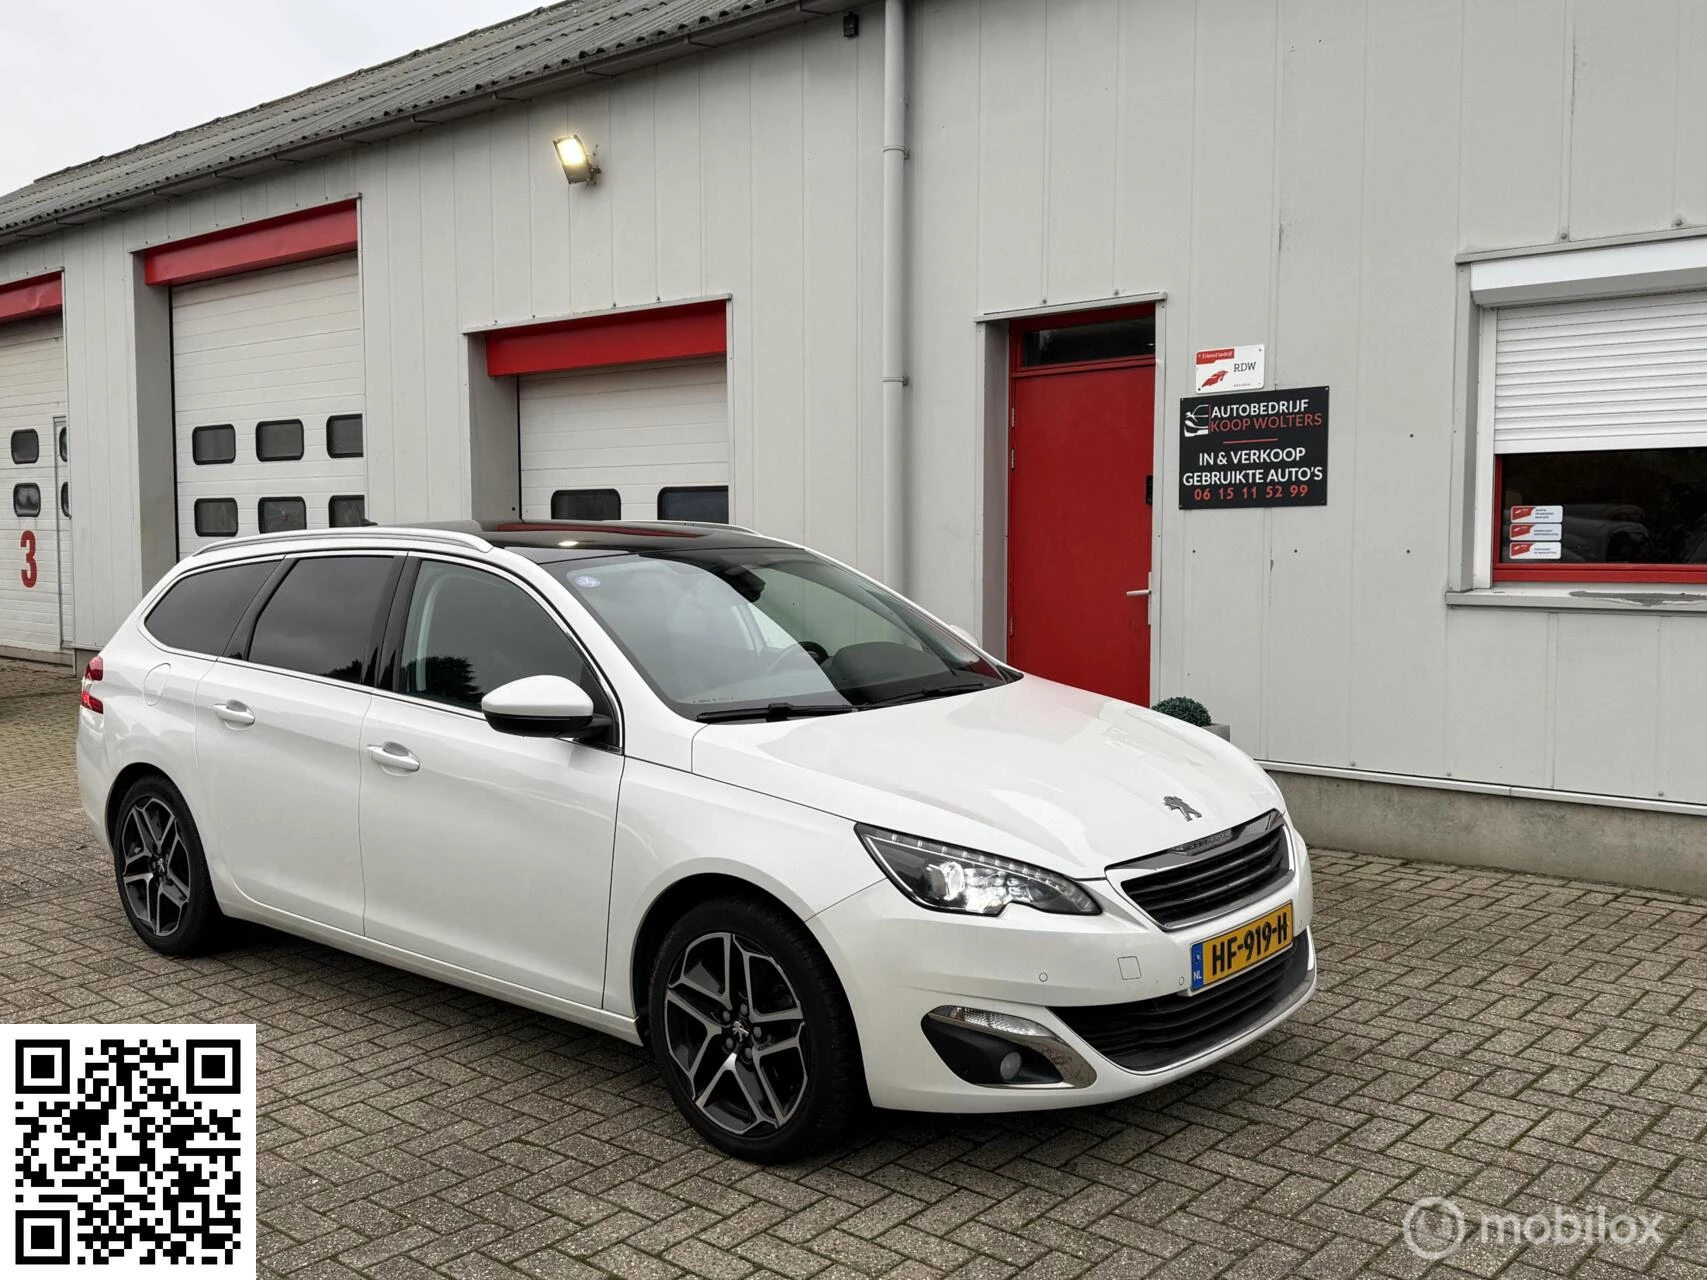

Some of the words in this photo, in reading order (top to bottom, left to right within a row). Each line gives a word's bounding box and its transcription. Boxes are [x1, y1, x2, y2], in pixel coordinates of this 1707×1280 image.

[1233, 361, 1257, 373] RDW
[1211, 399, 1309, 418] AUTOBEDRIJF
[1210, 418, 1251, 433] KOOP
[1253, 412, 1323, 430] WOLTERS
[1199, 452, 1214, 466] IN
[1217, 452, 1228, 465] &
[1231, 447, 1306, 464] VERKOOP
[1183, 469, 1264, 486] GEBRUIKTE
[1267, 466, 1323, 483] AUTO'S
[1194, 488, 1211, 500] 06
[1218, 487, 1234, 500] 15
[1242, 486, 1257, 499] 11
[1265, 485, 1283, 498] 52
[1289, 484, 1309, 497] 99
[20, 530, 38, 588] 3
[1212, 911, 1289, 976] HF-919-H
[1193, 970, 1203, 981] NL
